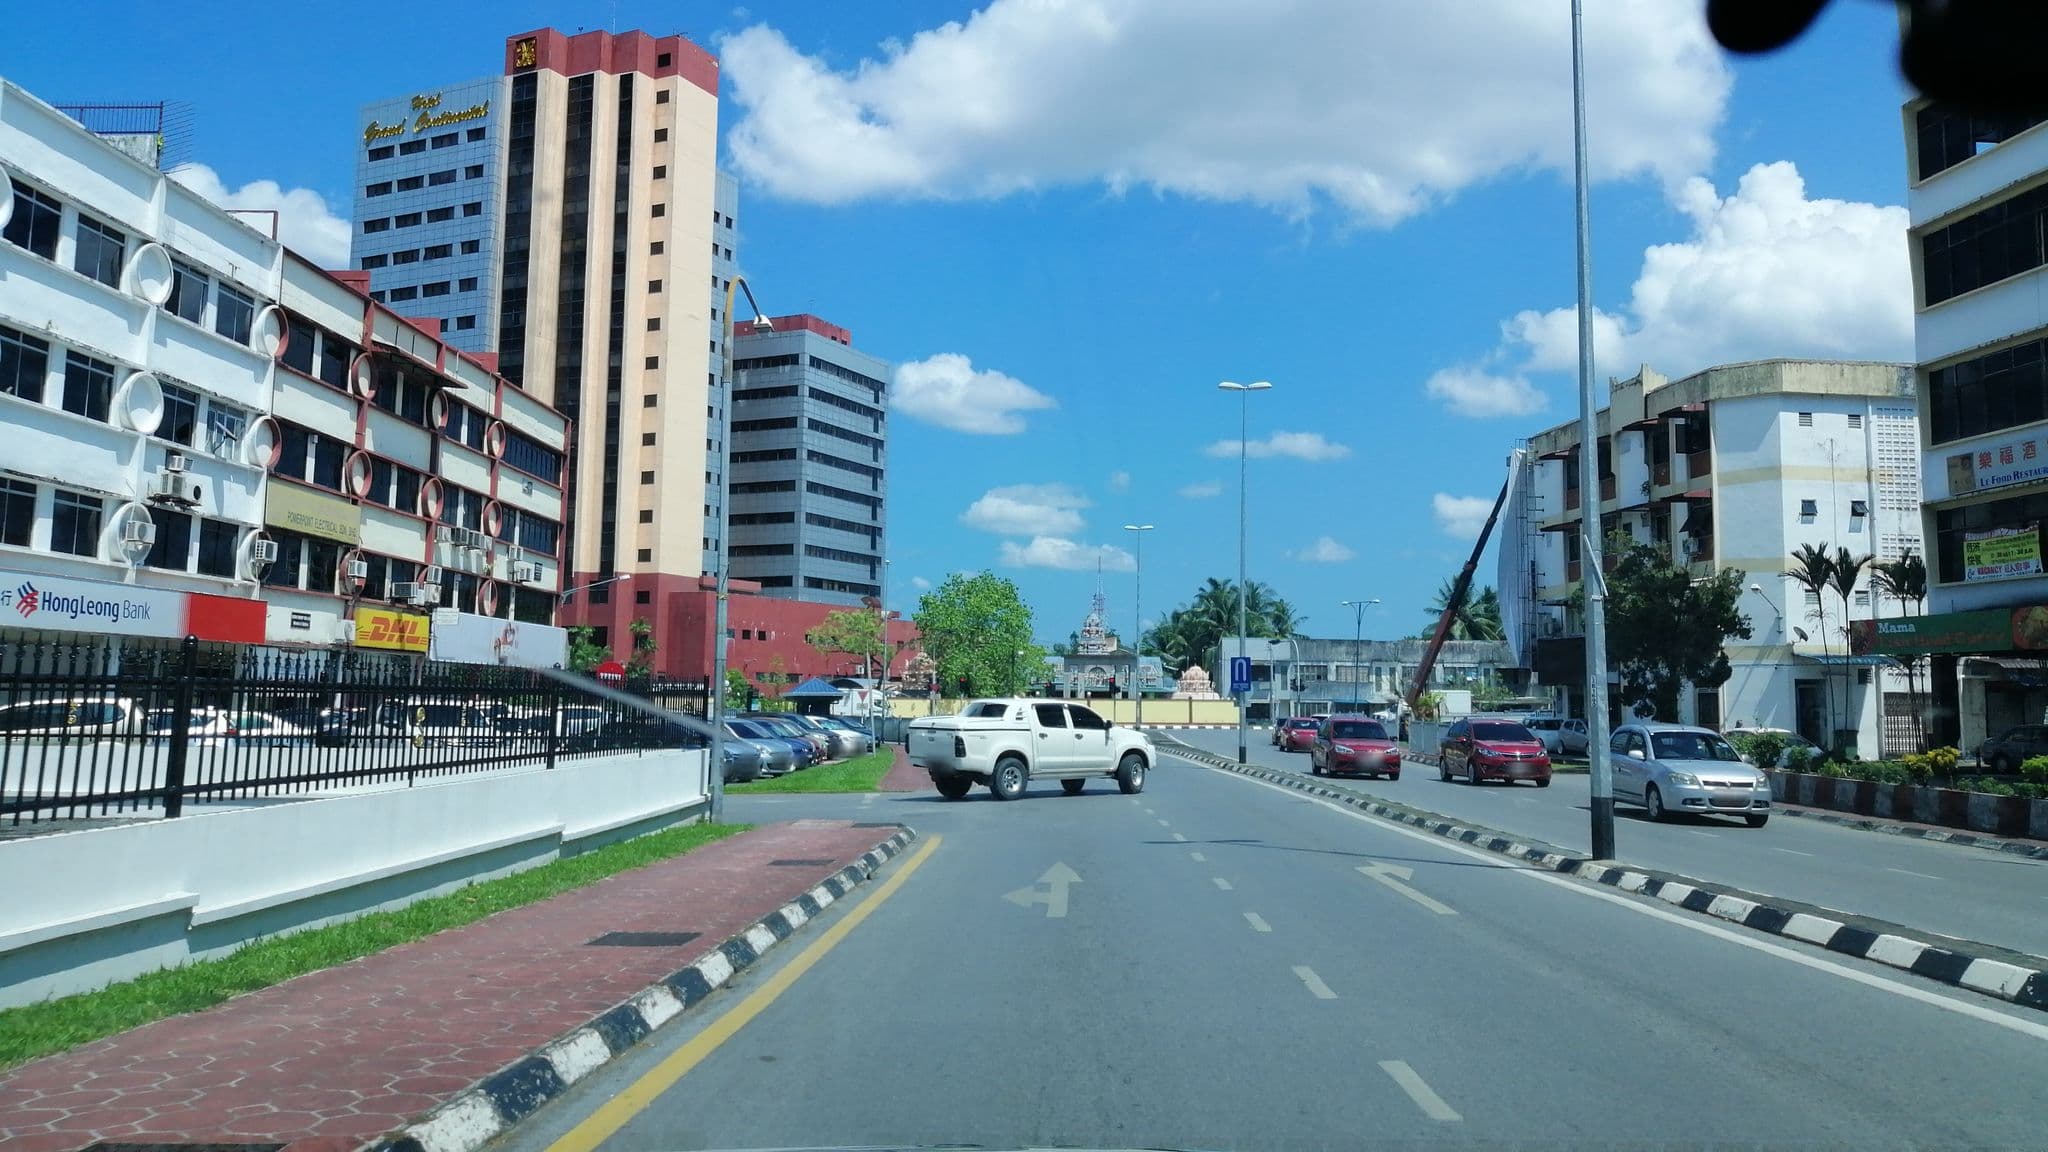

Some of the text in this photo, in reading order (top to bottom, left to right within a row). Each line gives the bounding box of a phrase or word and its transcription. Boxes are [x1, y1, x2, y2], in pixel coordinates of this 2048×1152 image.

[411, 90, 444, 111] Hotel
[363, 99, 491, 147] Grand Continental
[0, 590, 12, 606] 行
[42, 591, 151, 622] HongLeong Bank
[369, 616, 419, 644] DHL
[1878, 622, 1916, 634] Mama
